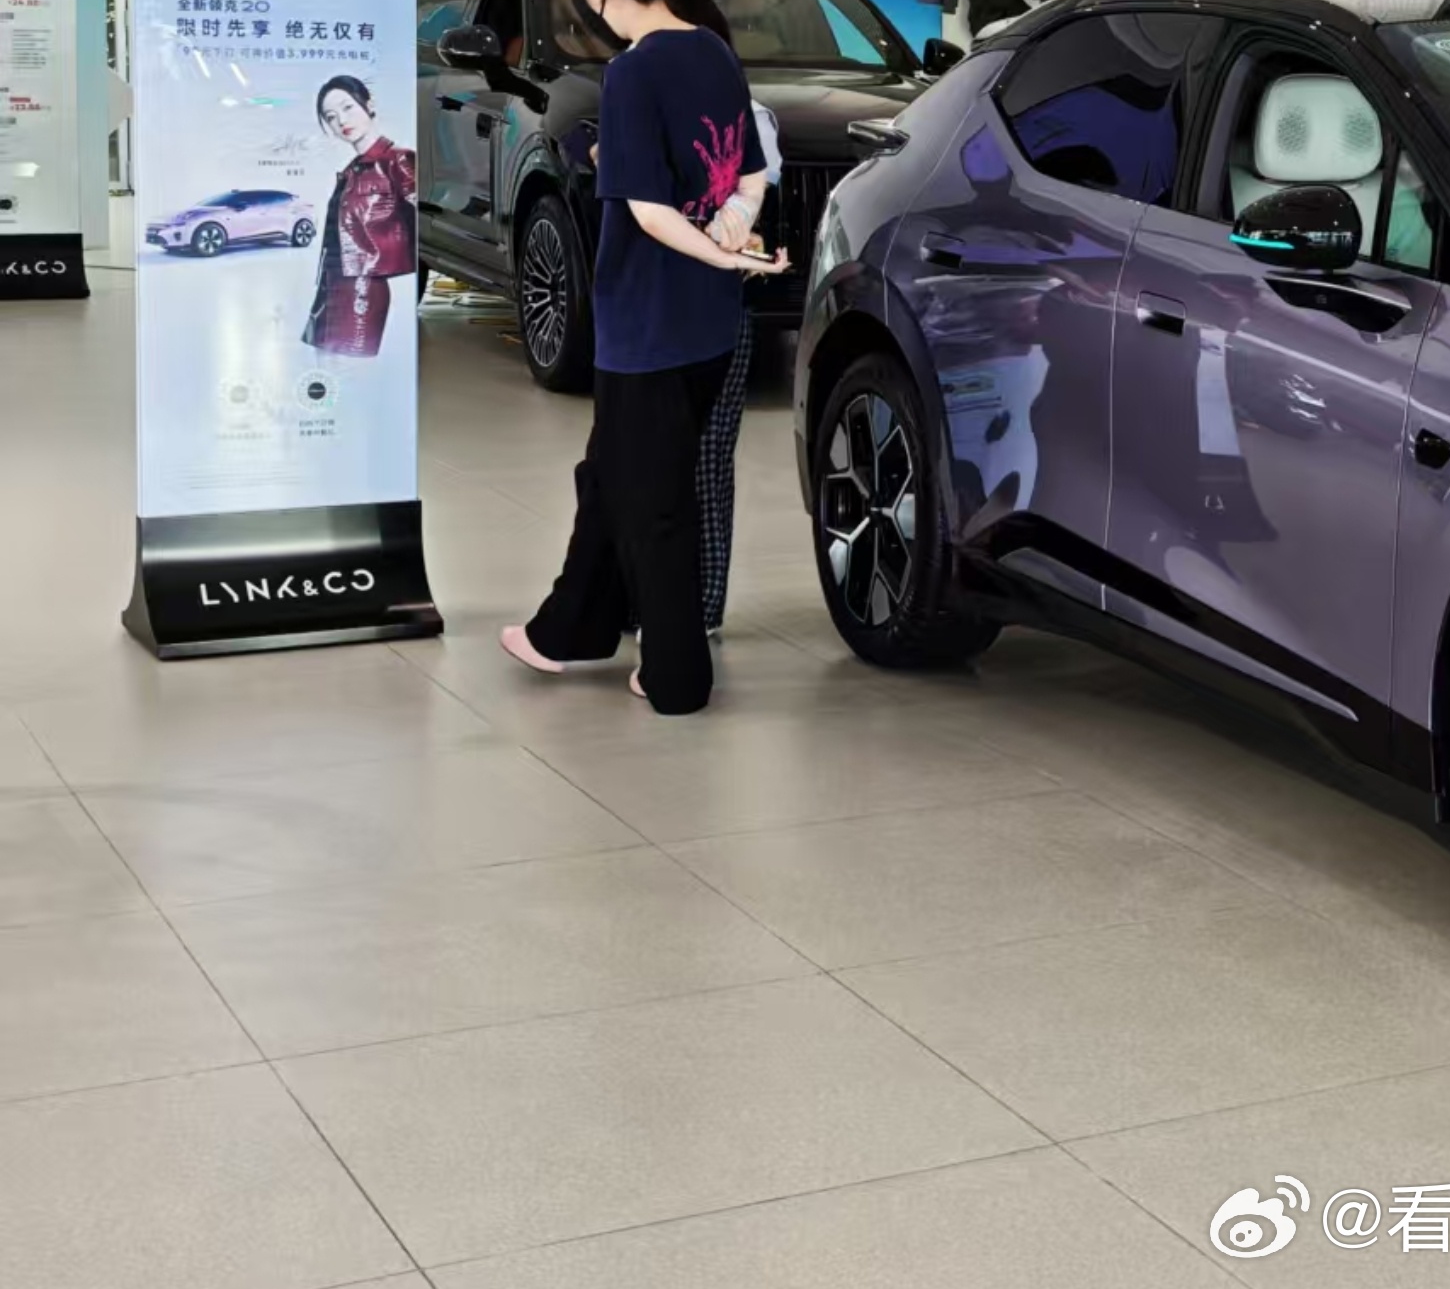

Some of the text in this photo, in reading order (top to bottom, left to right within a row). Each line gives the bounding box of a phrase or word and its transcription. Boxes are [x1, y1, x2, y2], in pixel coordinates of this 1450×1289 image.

[176, 17, 375, 41] 限时先享 绝无仅有
[200, 569, 374, 606] LYNK&CO
